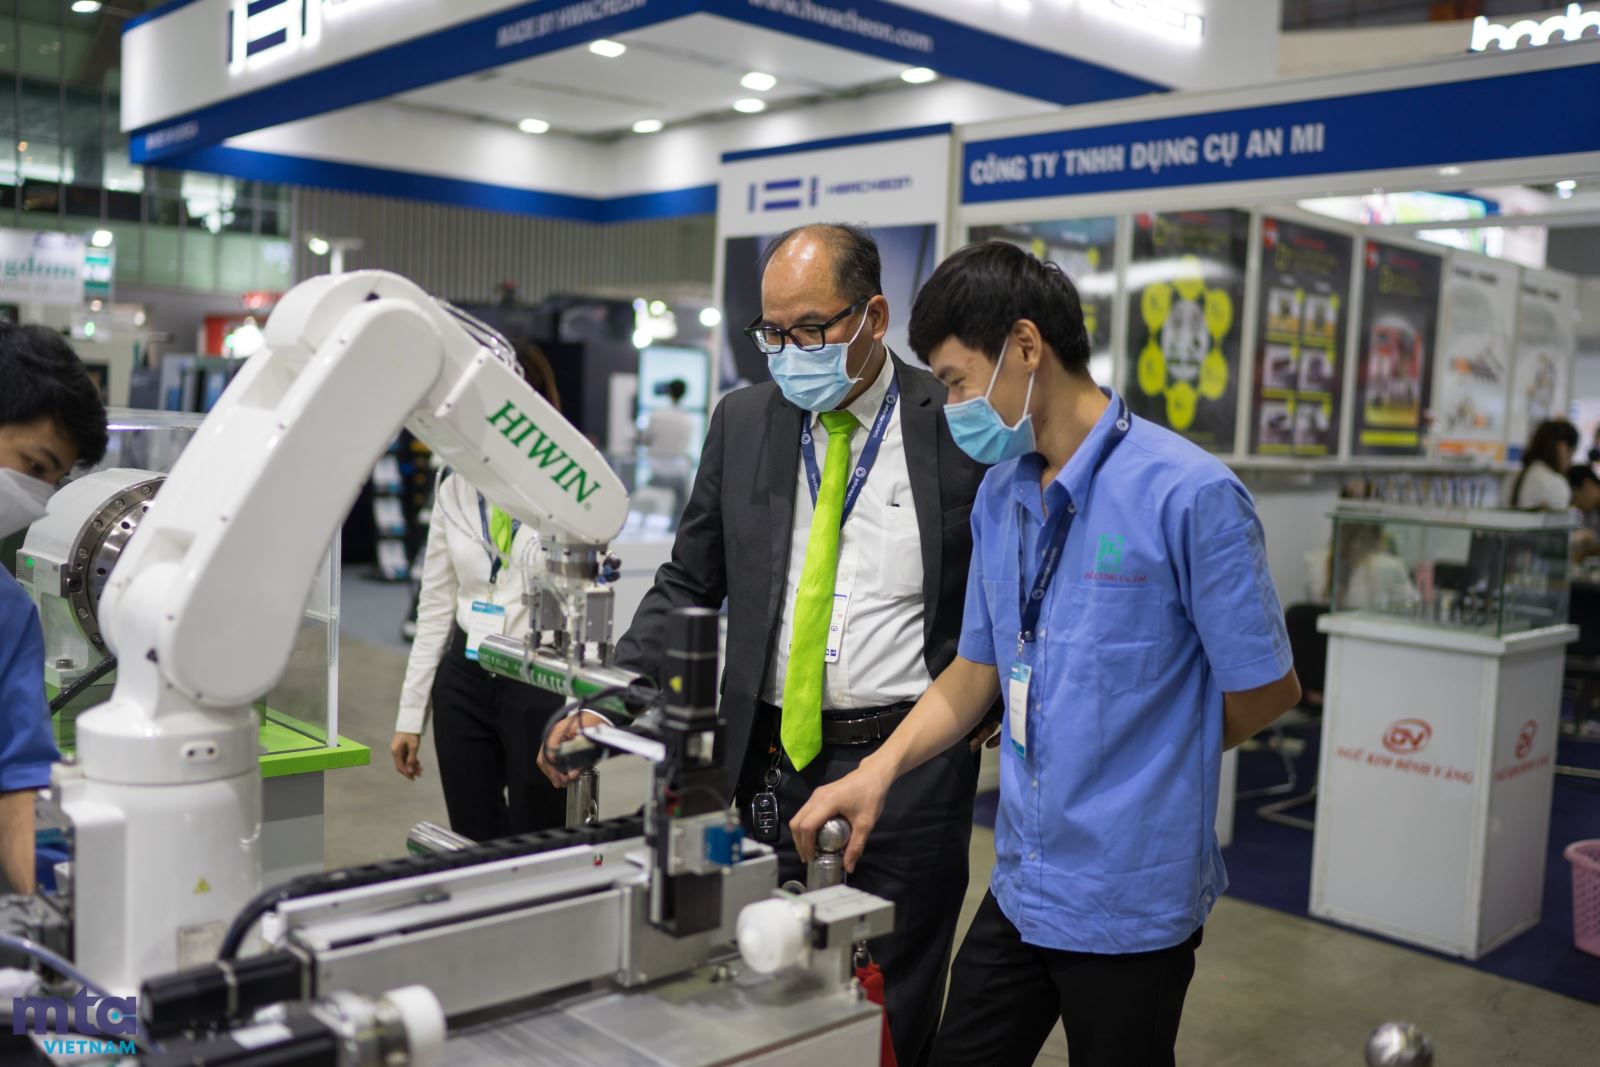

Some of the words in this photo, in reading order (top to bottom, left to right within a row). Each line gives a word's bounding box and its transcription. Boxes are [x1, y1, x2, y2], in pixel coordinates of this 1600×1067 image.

[969, 152, 1028, 186] CÔNG
[1029, 151, 1060, 180] TY
[1063, 144, 1126, 176] TNHH
[1129, 136, 1199, 175] DỤNG
[1203, 131, 1240, 168] CỤ
[1245, 127, 1284, 159] AN
[1290, 122, 1325, 155] MI
[0, 255, 77, 280] gdom
[485, 400, 601, 503] HIWIN
